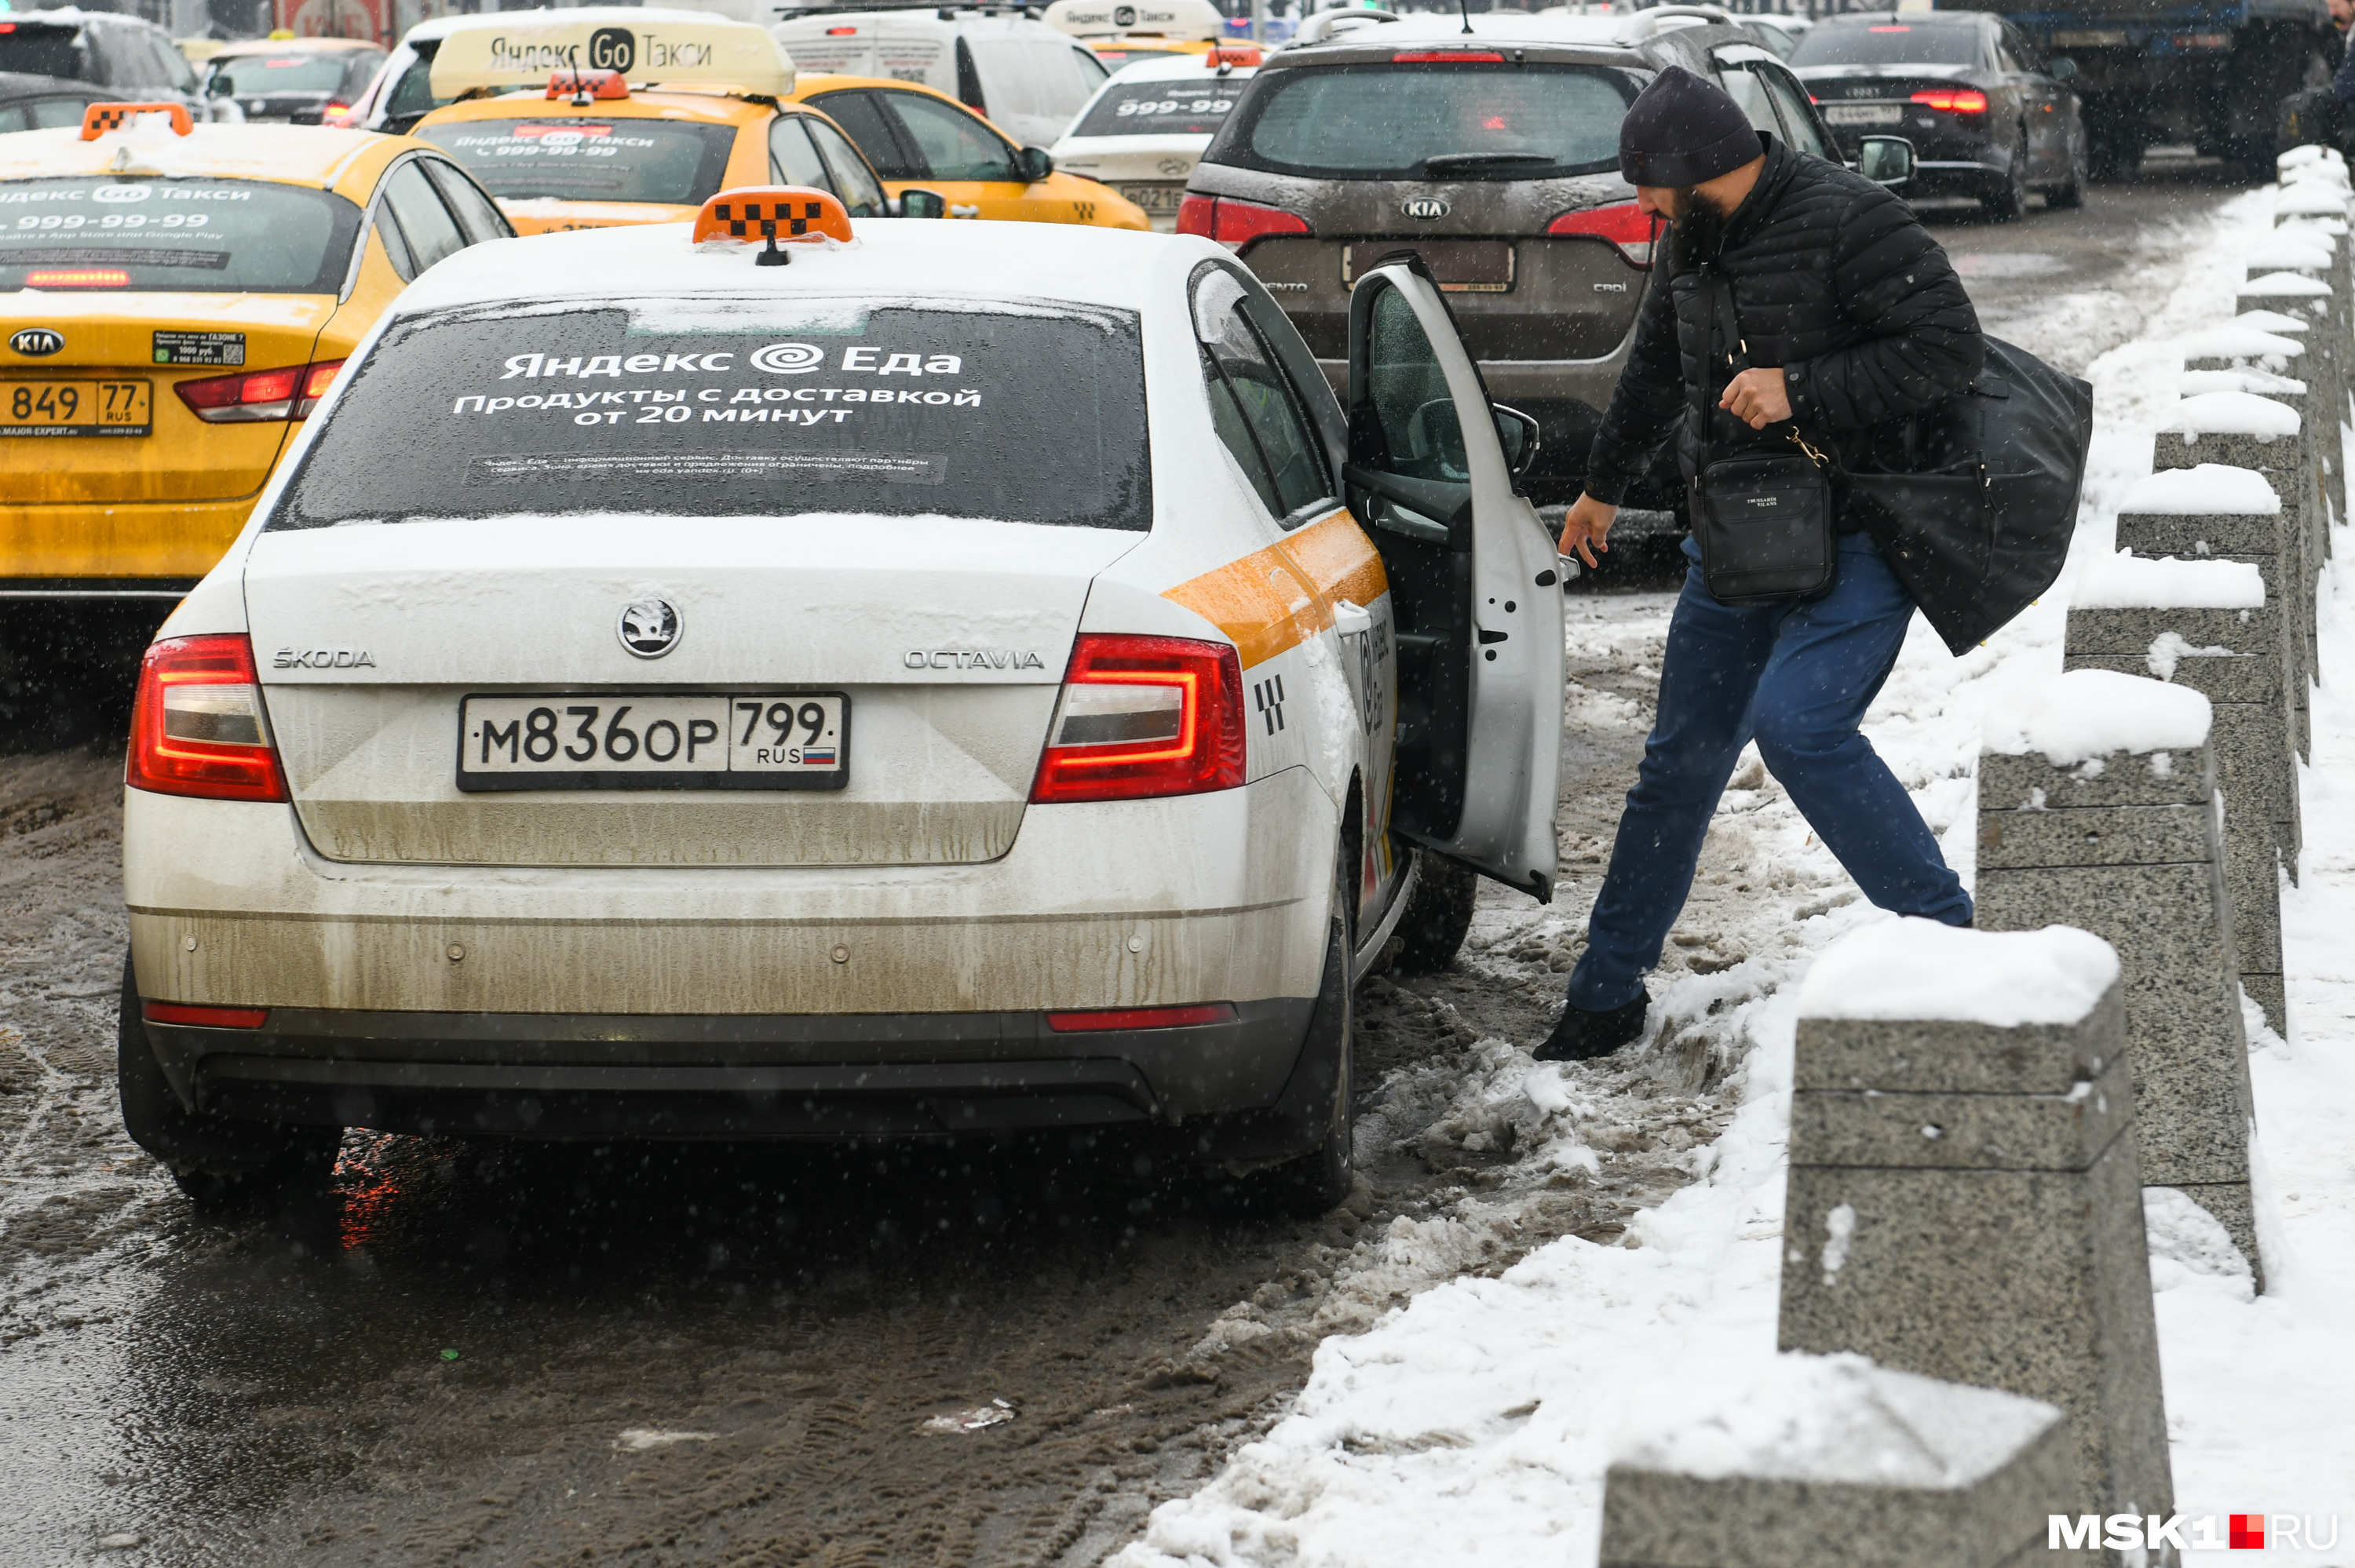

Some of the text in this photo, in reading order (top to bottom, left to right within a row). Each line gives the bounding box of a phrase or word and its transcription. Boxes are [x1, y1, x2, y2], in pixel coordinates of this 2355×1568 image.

[491, 34, 711, 72] Яндекс Go Такси
[455, 136, 536, 147] Яндекс
[589, 137, 654, 148] Такси
[495, 145, 617, 156] 999-99-99
[159, 187, 251, 201] Такси
[1409, 203, 1443, 216] KIA
[16, 214, 209, 230] 999-99-99
[1262, 283, 1308, 291] ENTO
[17, 334, 56, 352] KIA
[498, 347, 962, 379] Яндекс Еда
[12, 387, 78, 420] 849
[103, 385, 137, 410] 77
[453, 388, 982, 414] Продукты с доставкой
[107, 412, 132, 421] RUS
[574, 406, 853, 425] от 20 минут
[273, 647, 377, 668] ŠKODA
[904, 650, 1045, 669] OCTAVIA
[735, 702, 825, 747] 799
[480, 706, 718, 764] М836ОР
[757, 748, 801, 764] RUS
